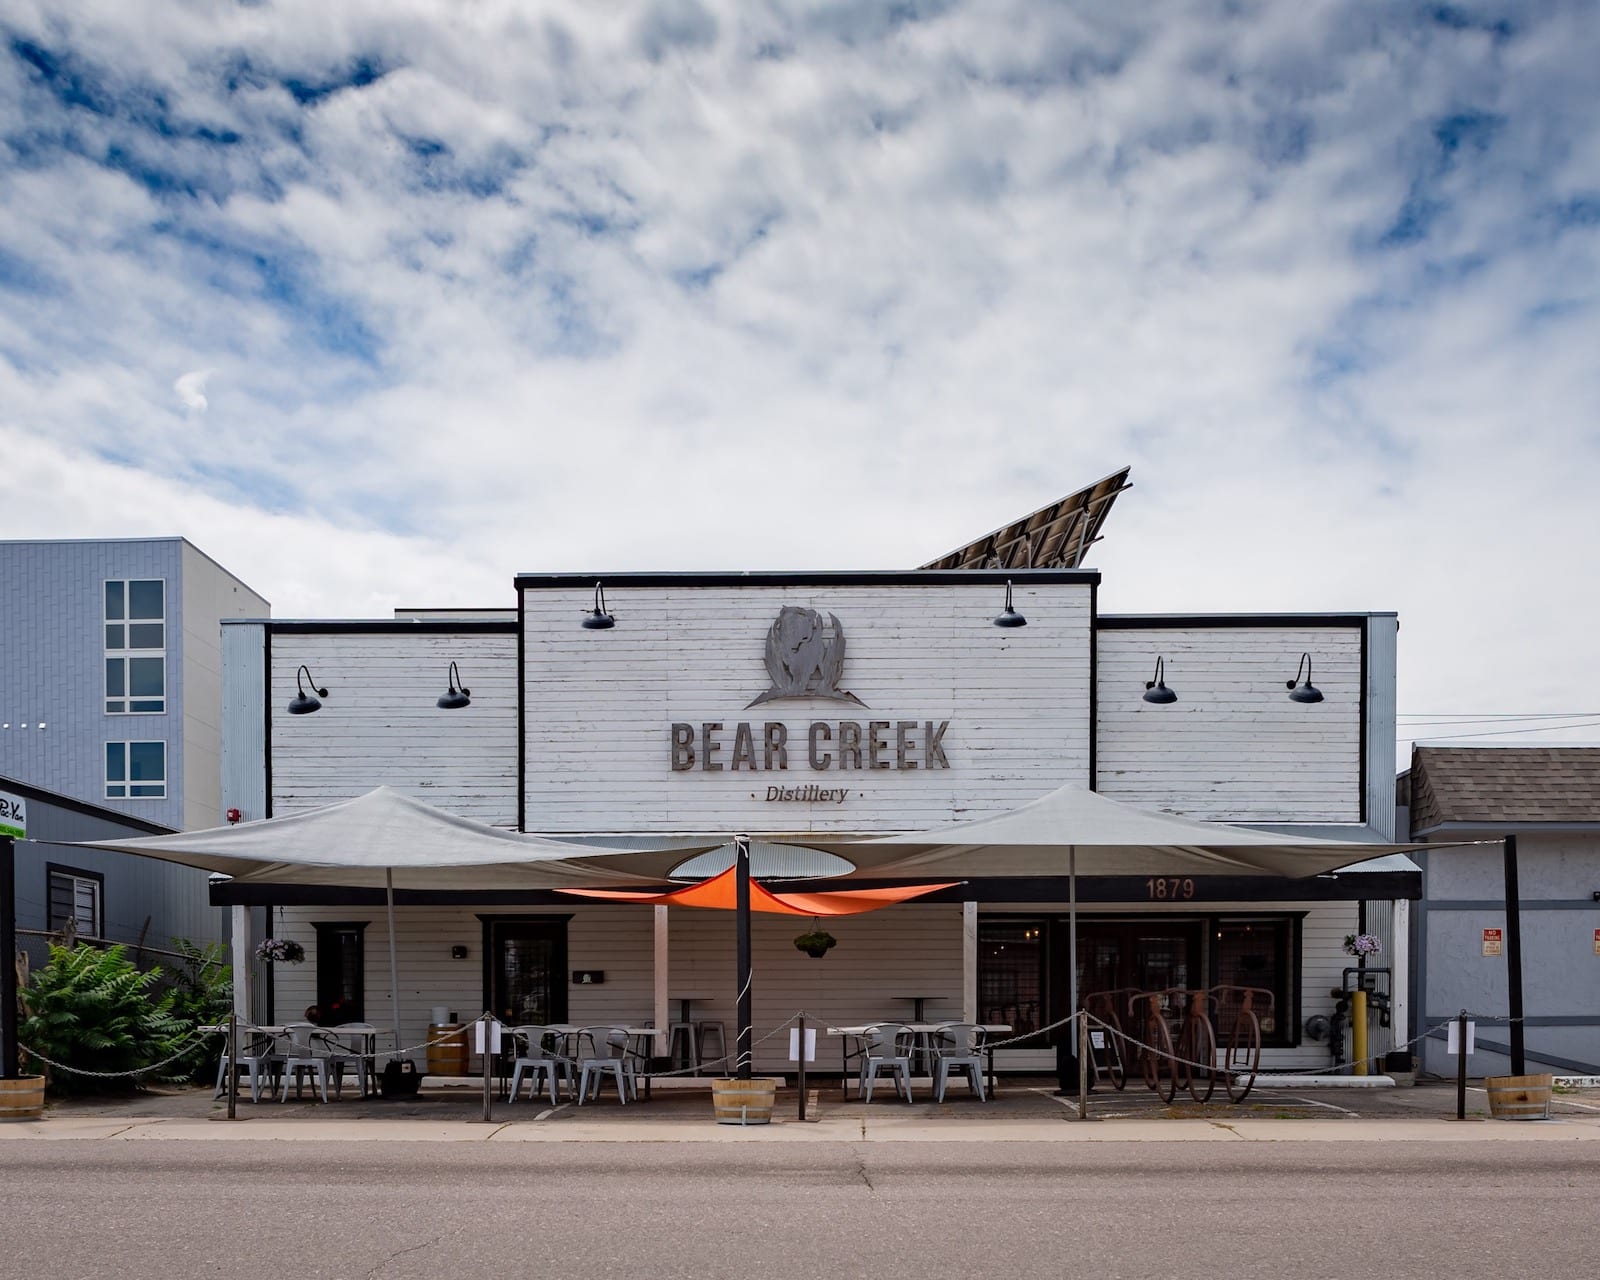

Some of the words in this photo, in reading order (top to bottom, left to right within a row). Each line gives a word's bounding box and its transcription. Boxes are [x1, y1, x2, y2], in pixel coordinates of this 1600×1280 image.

[671, 722, 788, 771] BEAR
[808, 720, 950, 770] CREEK
[765, 785, 849, 804] Distillery
[1146, 879, 1194, 898] 1879
